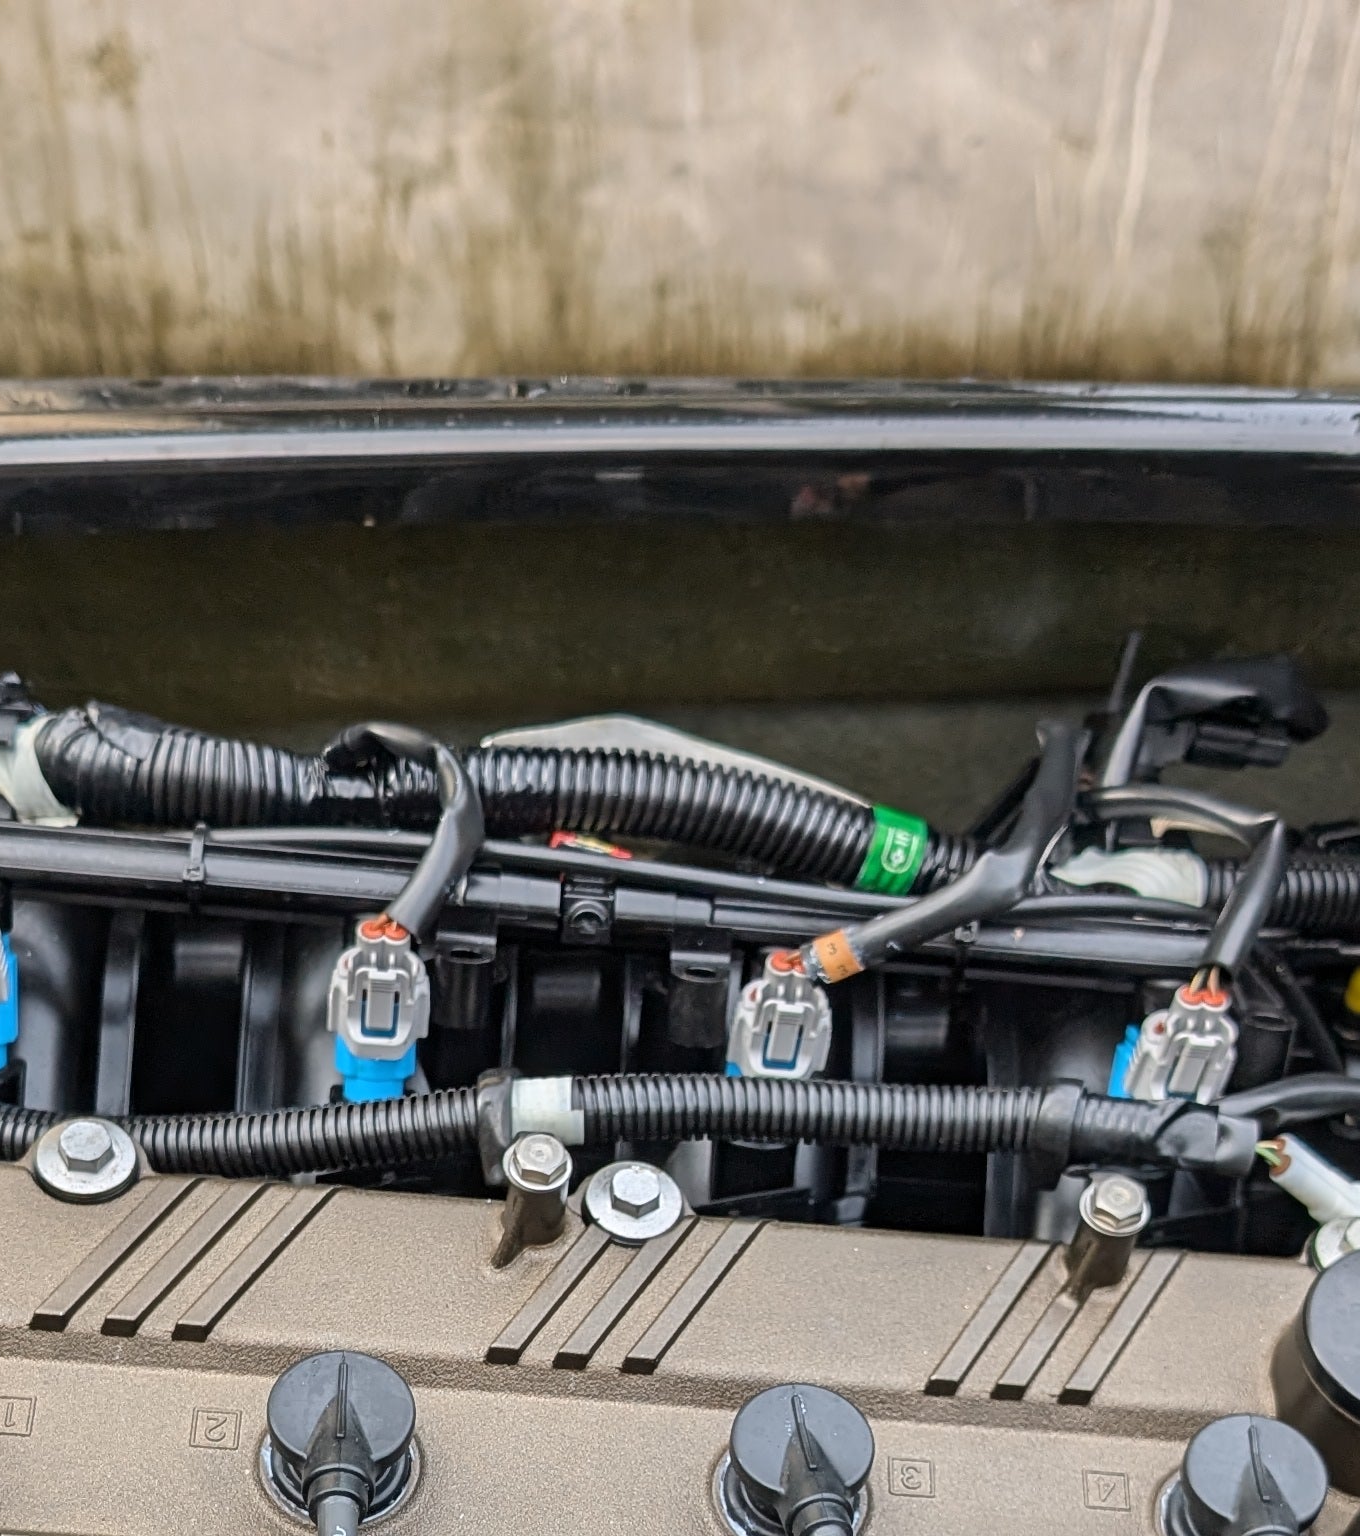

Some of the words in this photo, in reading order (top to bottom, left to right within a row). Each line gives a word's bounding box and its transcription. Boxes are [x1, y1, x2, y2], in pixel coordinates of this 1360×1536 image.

[3, 1402, 16, 1428] 1
[204, 1415, 228, 1442] 2
[900, 1464, 922, 1491] 3
[1094, 1476, 1117, 1503] 4
